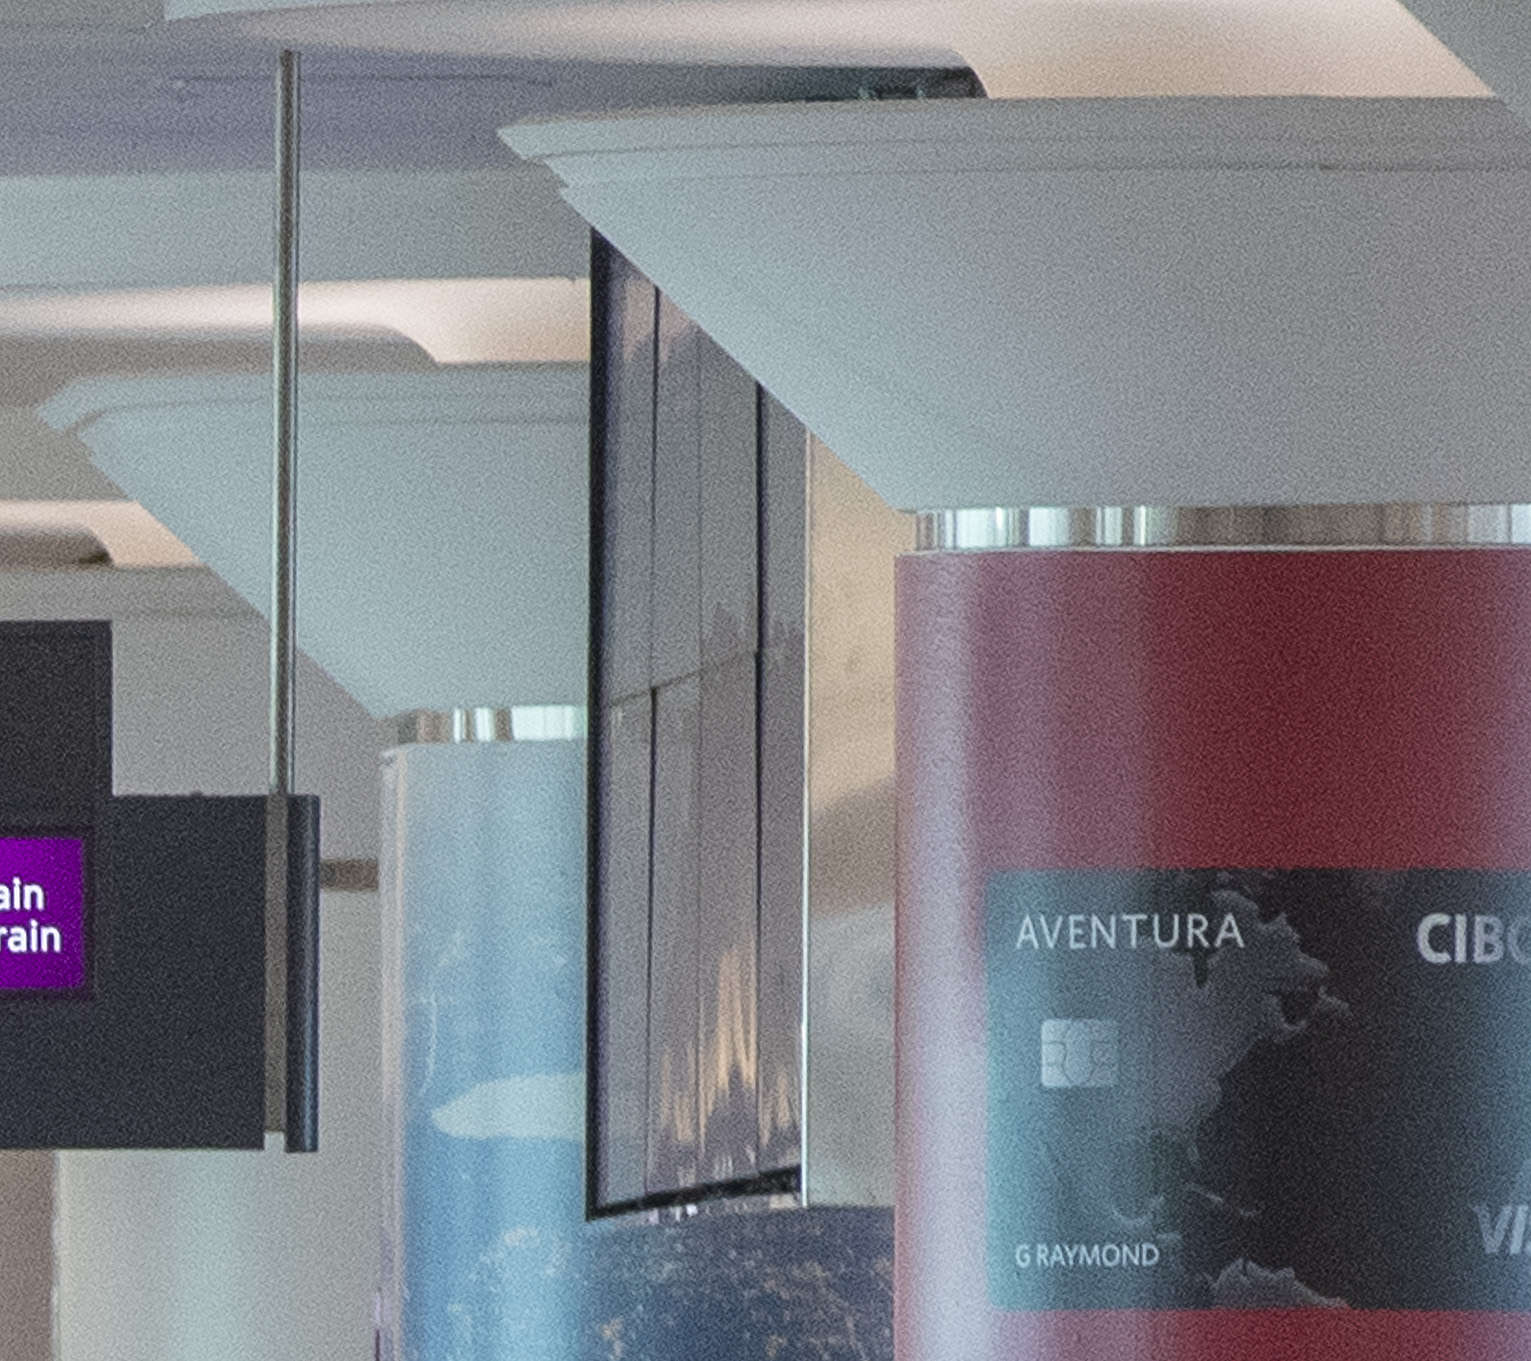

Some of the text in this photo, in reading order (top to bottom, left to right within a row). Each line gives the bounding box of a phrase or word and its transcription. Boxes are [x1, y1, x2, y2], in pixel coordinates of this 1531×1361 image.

[1015, 912, 1244, 949] AVENTURA
[1472, 1203, 1531, 1254] VI
[1014, 1244, 1159, 1268] G RAYMOND
